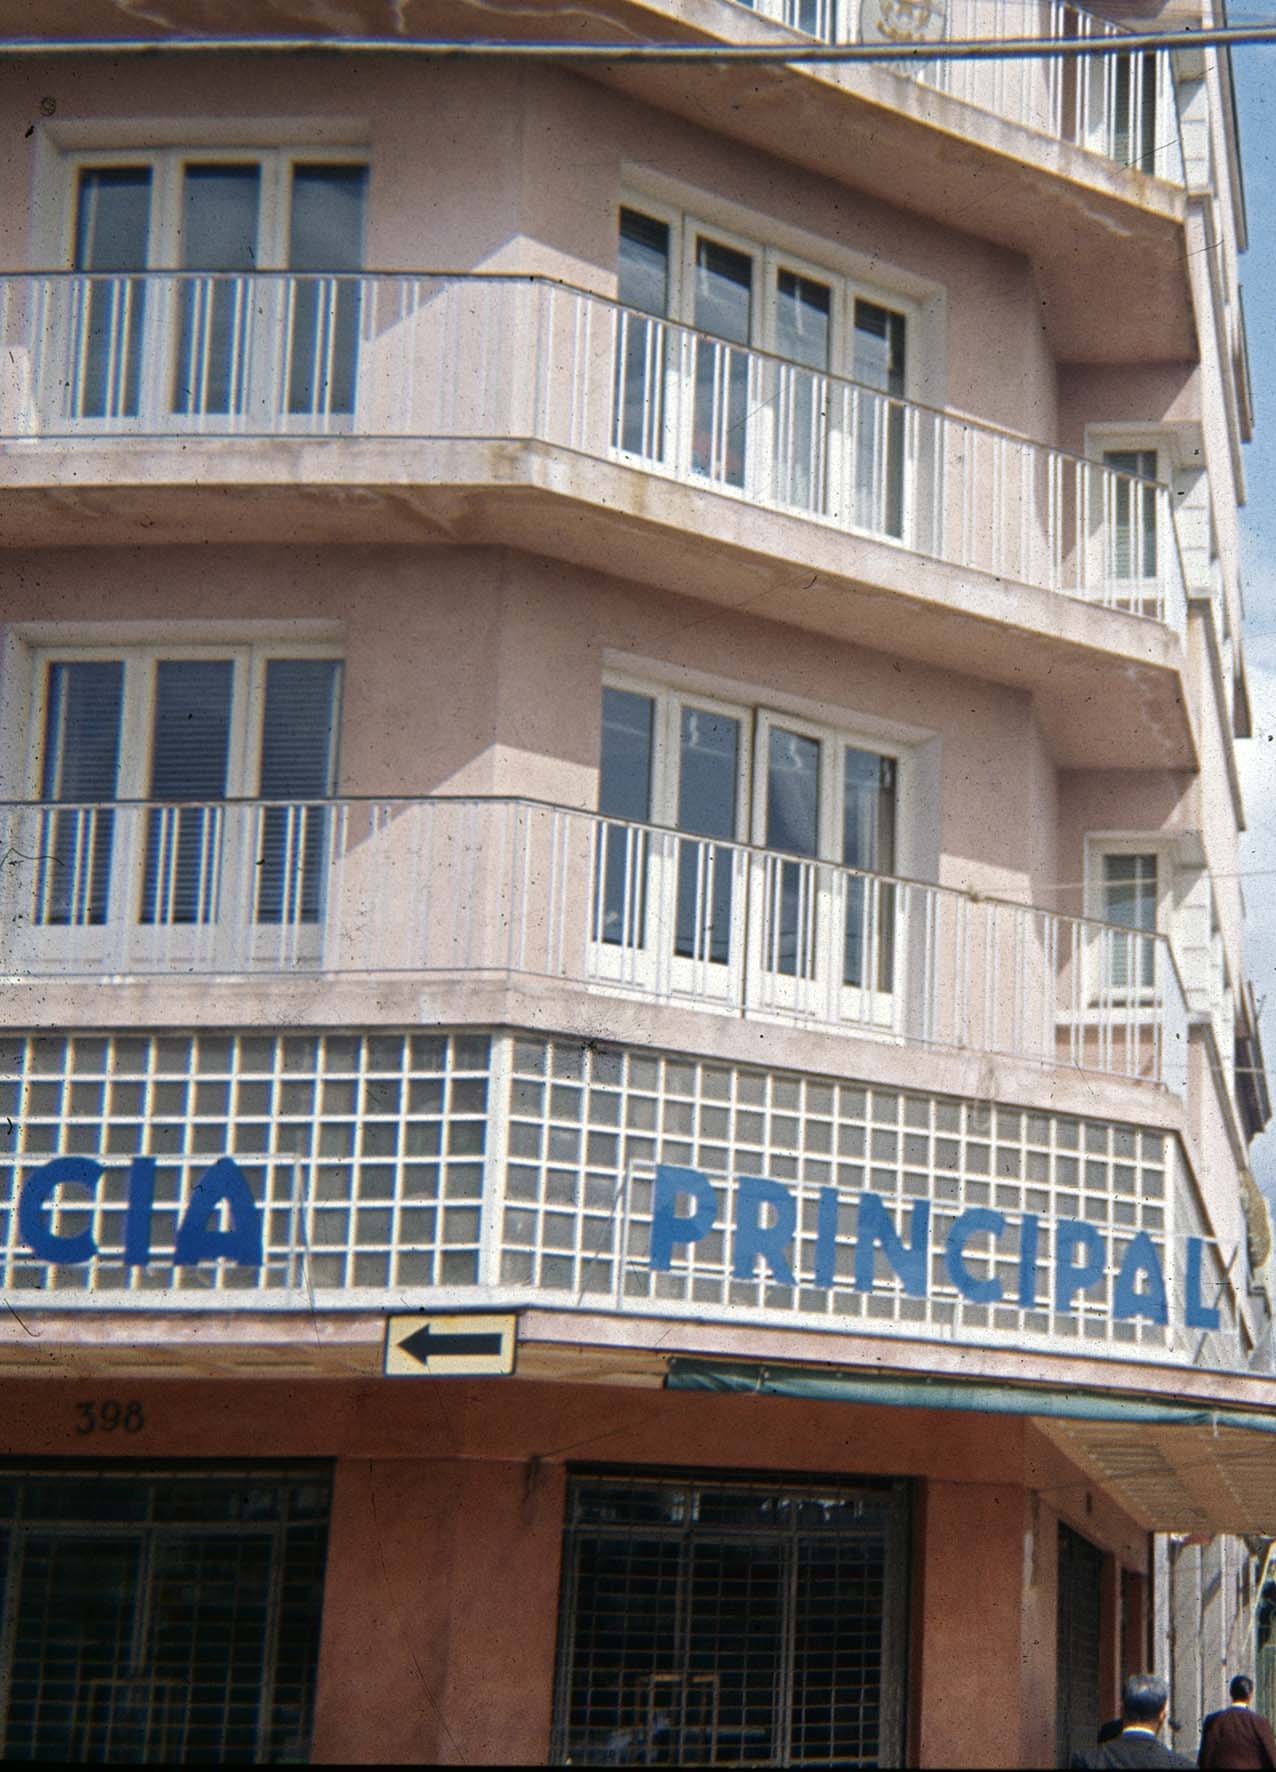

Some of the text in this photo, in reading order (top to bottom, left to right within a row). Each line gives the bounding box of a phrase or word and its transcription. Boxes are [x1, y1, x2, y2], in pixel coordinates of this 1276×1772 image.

[18, 1156, 264, 1266] CIA
[649, 1163, 1220, 1330] PRINCIPAL
[74, 1400, 145, 1434] 398
